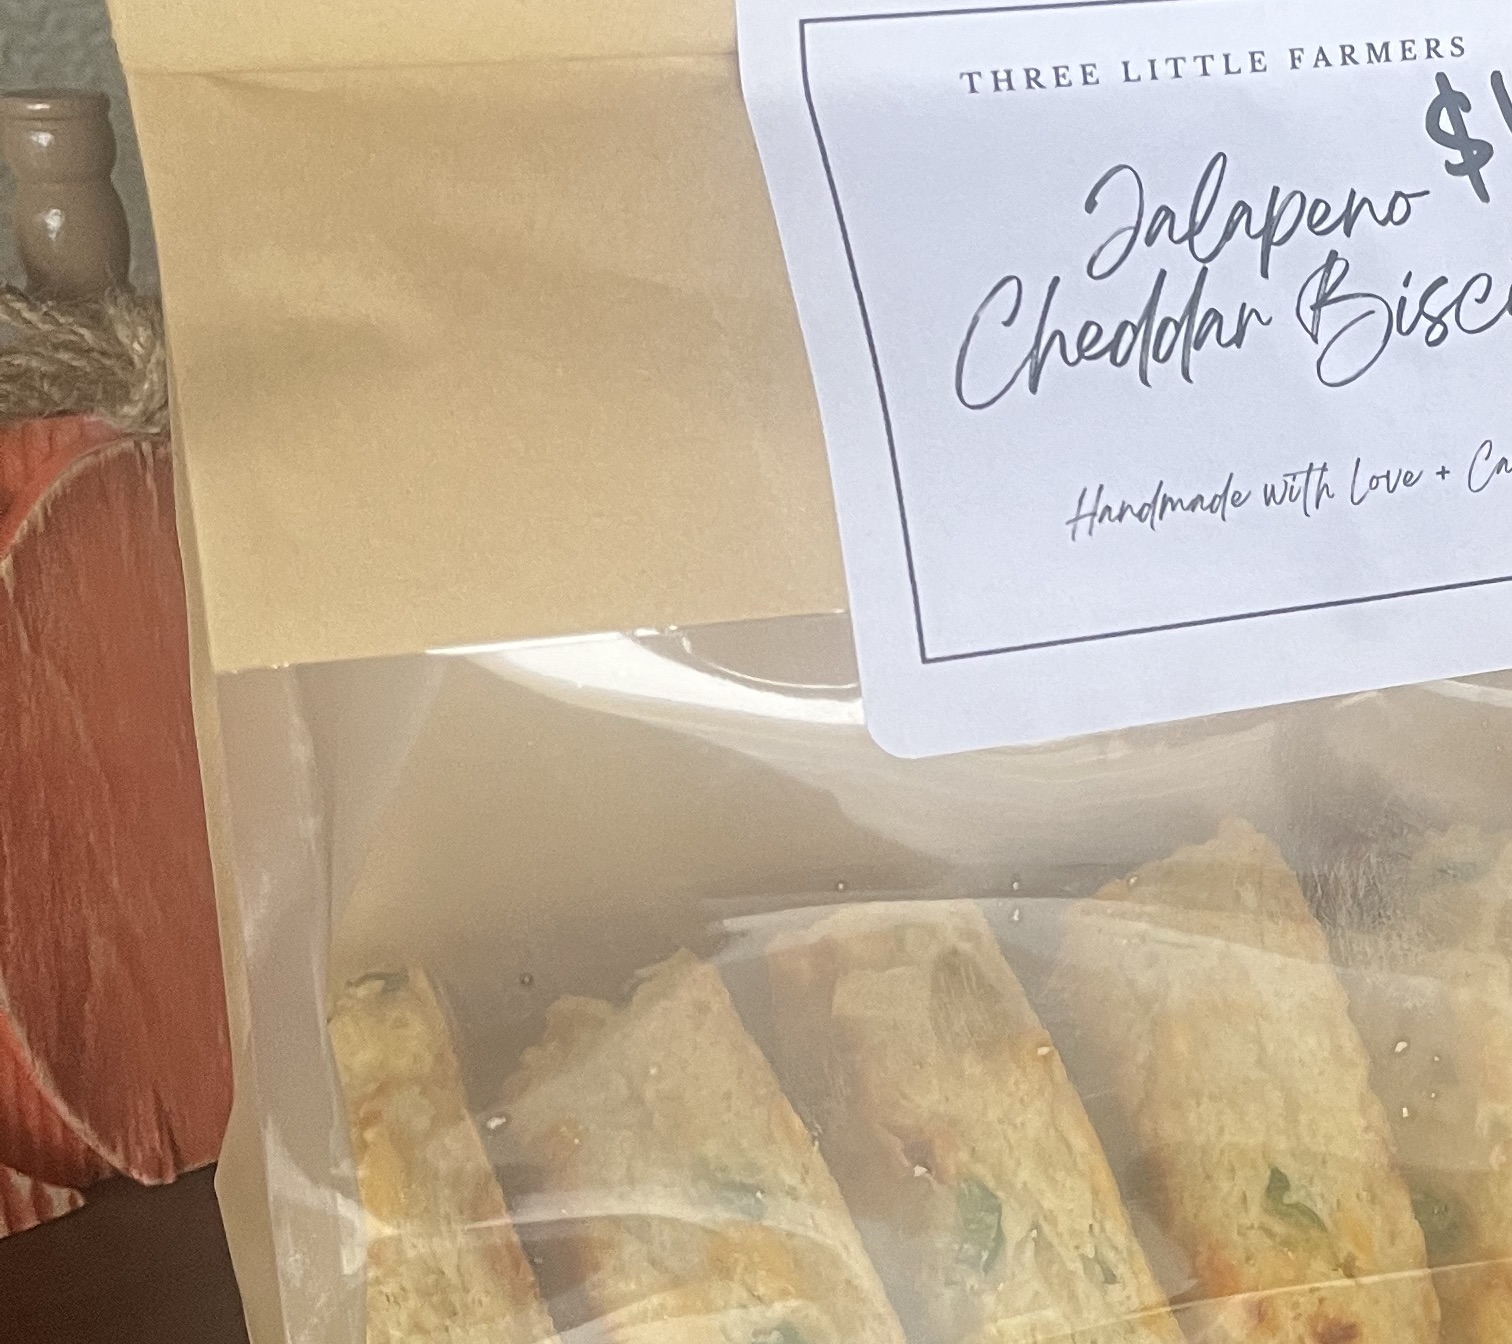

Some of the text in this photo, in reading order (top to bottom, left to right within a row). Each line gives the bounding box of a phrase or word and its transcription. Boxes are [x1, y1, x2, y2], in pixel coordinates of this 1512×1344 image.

[959, 34, 1467, 95] THREE LITTLE FARMERS
[1084, 152, 1432, 280] Jalapeno
[955, 265, 1274, 410] Cheddar
[1065, 480, 1252, 542] Handmade
[1262, 460, 1336, 519] with
[1349, 455, 1424, 507] Love
[1435, 464, 1451, 481] +
